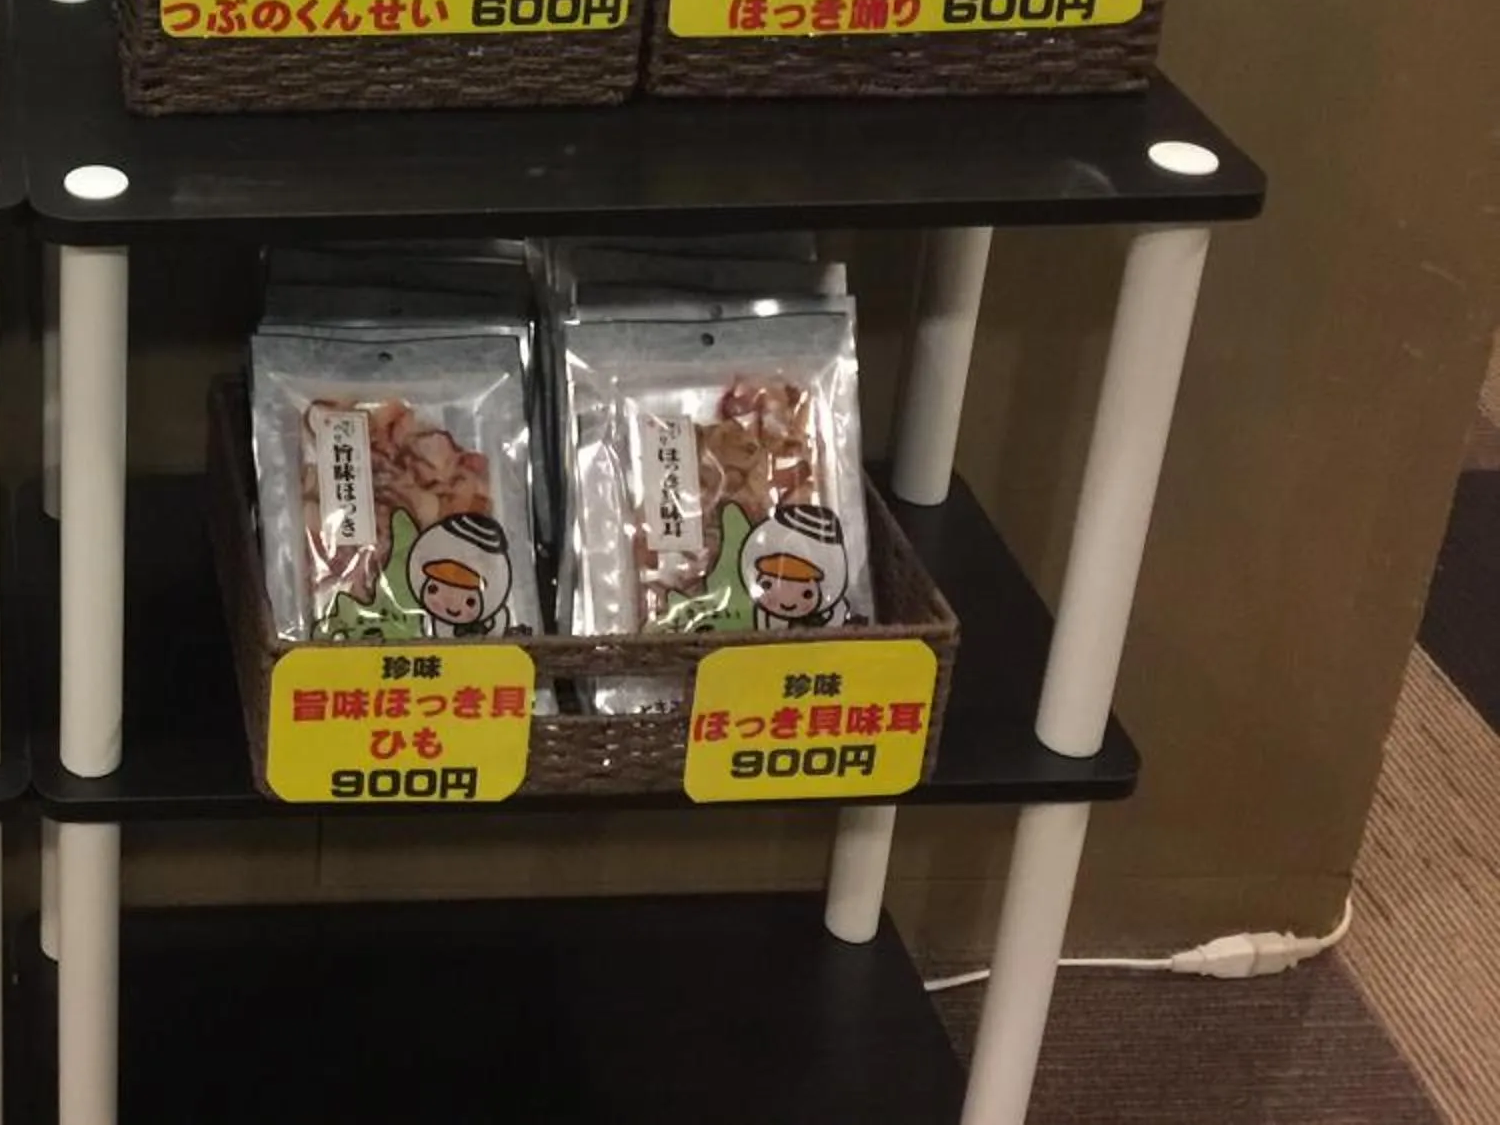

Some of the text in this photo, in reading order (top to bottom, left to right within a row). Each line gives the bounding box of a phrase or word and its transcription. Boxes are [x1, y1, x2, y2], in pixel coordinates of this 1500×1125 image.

[382, 655, 441, 681] 珍味
[782, 673, 842, 698] 珍味
[292, 686, 527, 723] 旨味ほっき貝
[692, 700, 927, 744] ほっき貝味耳
[369, 728, 444, 761] ひも
[729, 743, 877, 780] 900円
[330, 767, 478, 802] 900円
